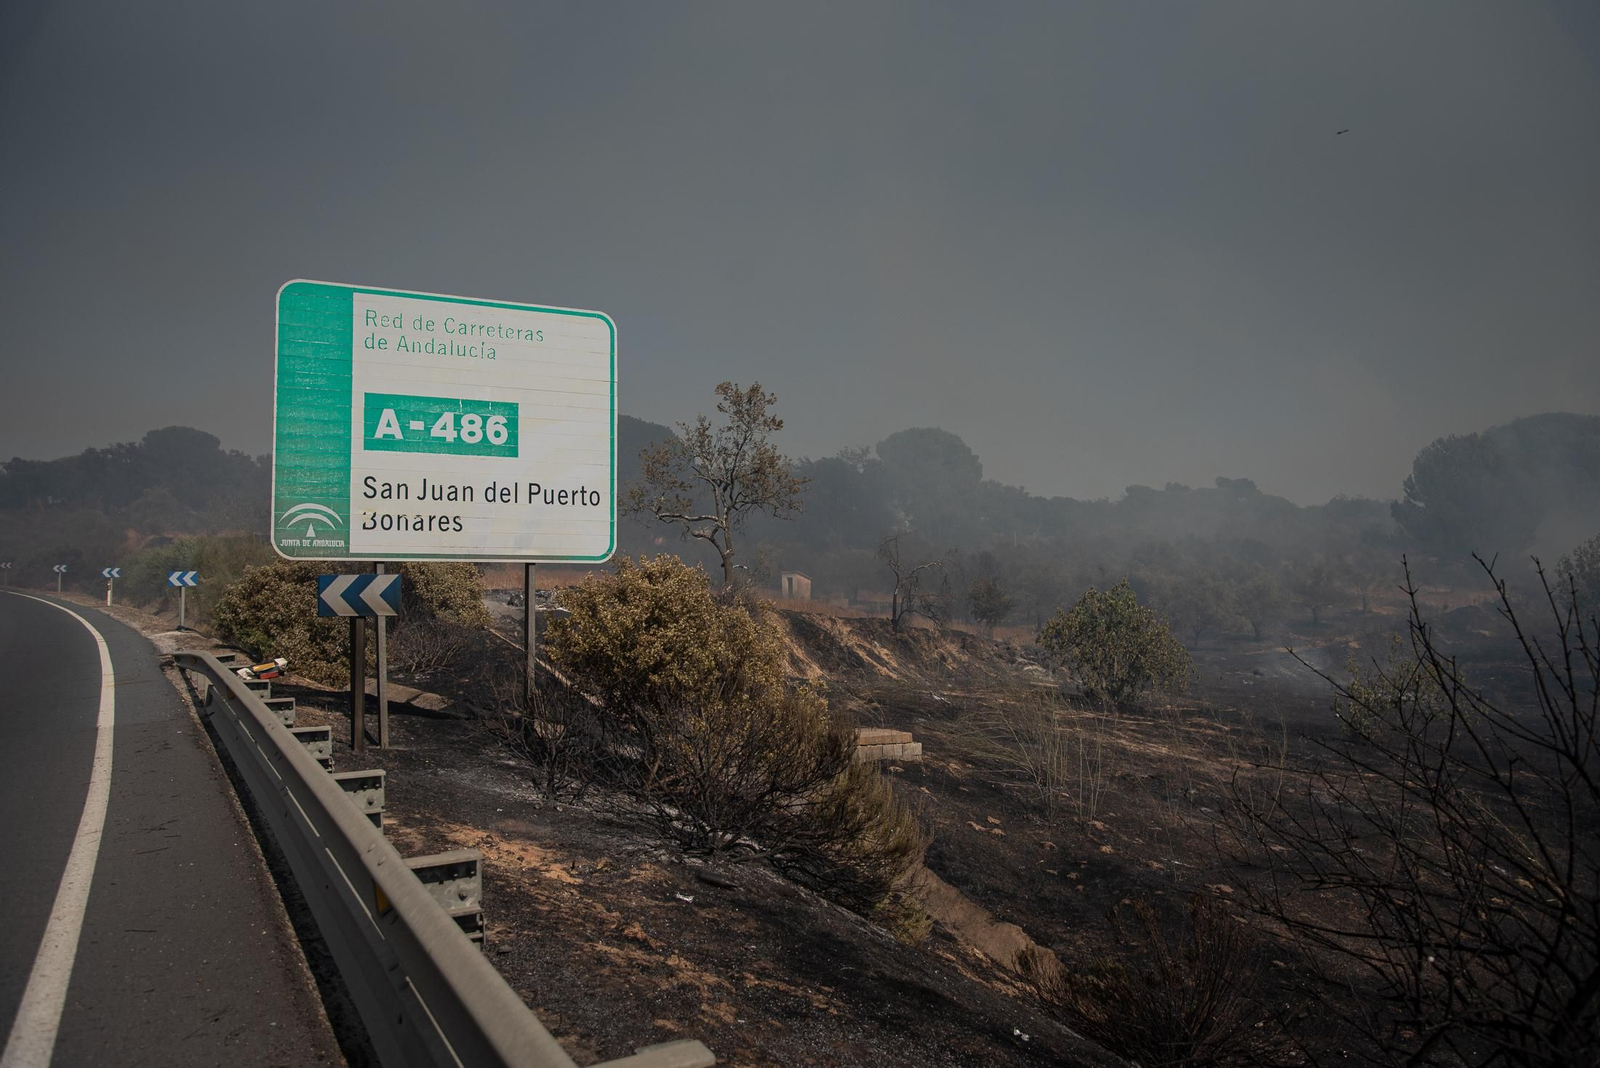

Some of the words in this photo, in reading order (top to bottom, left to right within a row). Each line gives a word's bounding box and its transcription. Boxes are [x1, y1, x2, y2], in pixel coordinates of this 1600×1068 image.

[364, 332, 388, 350] de
[365, 309, 403, 330] Red
[412, 314, 435, 332] de
[443, 317, 545, 343] Carreteras
[374, 408, 509, 446] A-486
[362, 475, 409, 500] San
[416, 478, 474, 502] Juan
[484, 481, 518, 504] del
[528, 482, 601, 506] Puerto
[280, 539, 300, 547] JUNTA
[302, 539, 311, 547] DE
